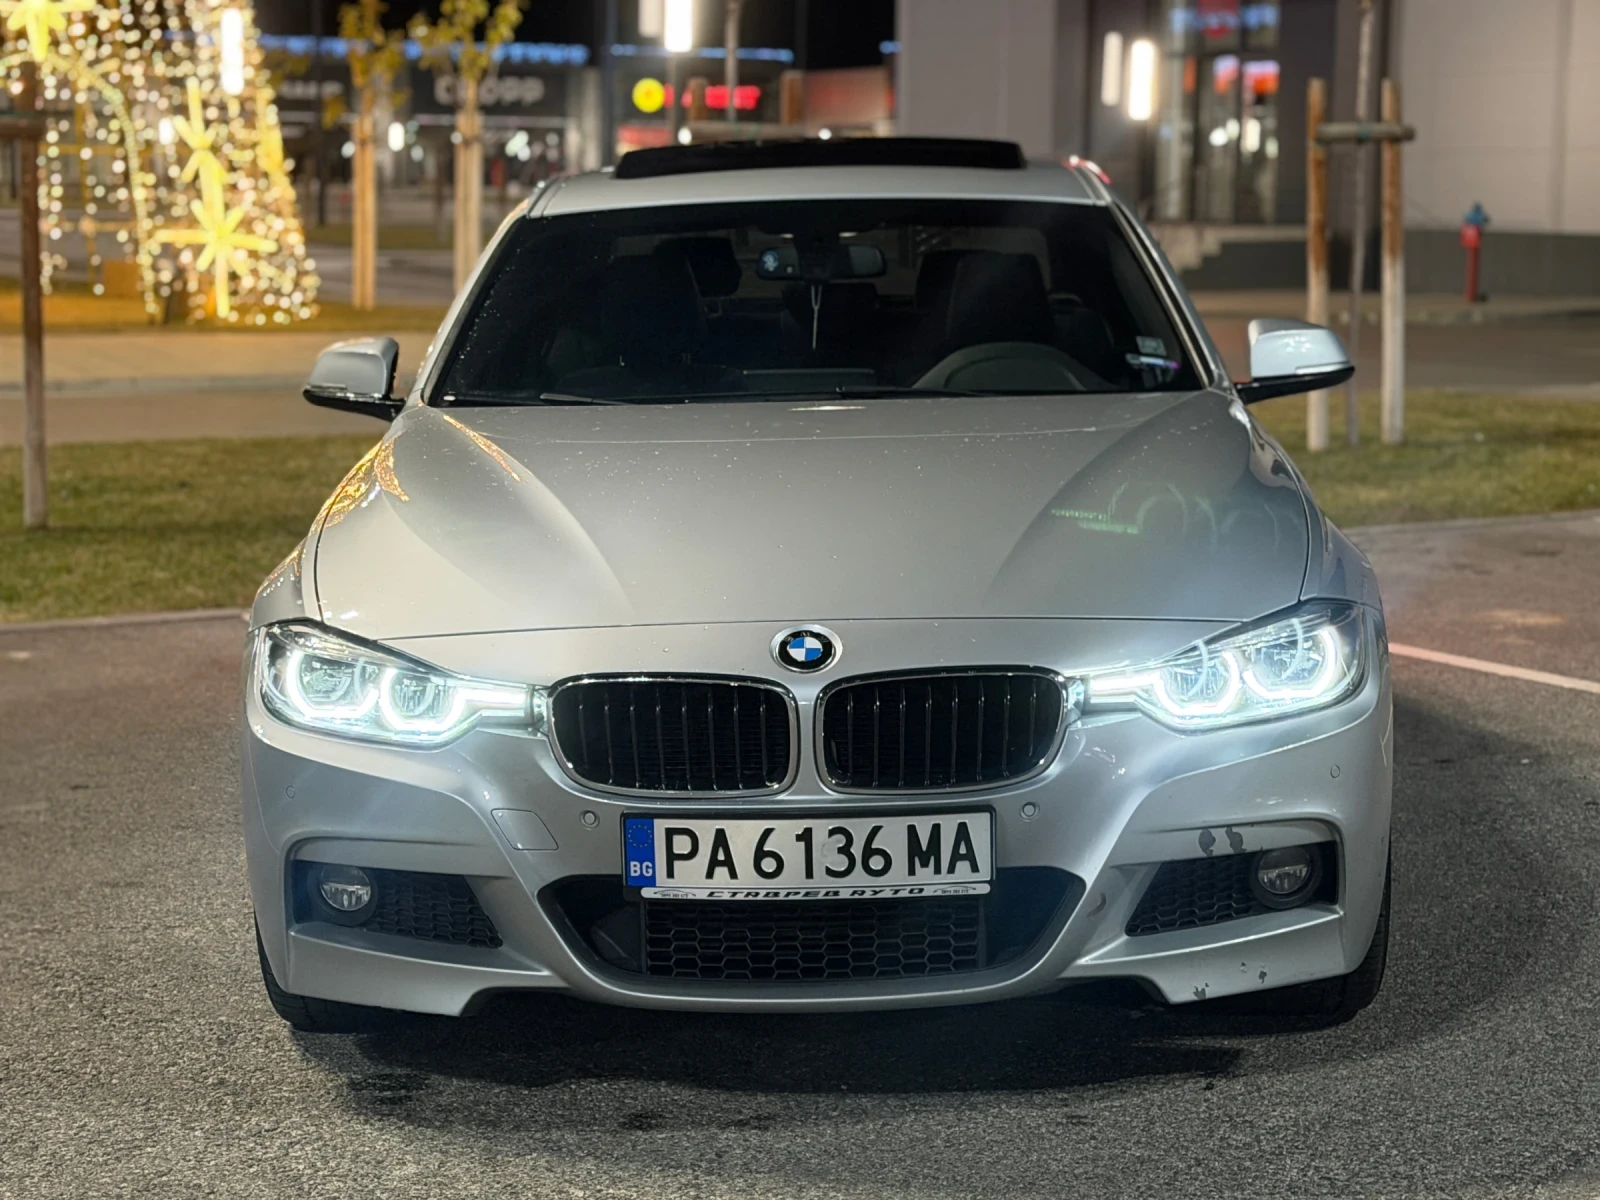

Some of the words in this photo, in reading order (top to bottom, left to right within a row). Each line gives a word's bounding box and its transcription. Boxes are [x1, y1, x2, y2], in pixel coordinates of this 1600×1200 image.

[630, 861, 653, 877] BG
[664, 827, 739, 880] PA
[753, 825, 893, 880] 6136
[906, 821, 980, 876] MA
